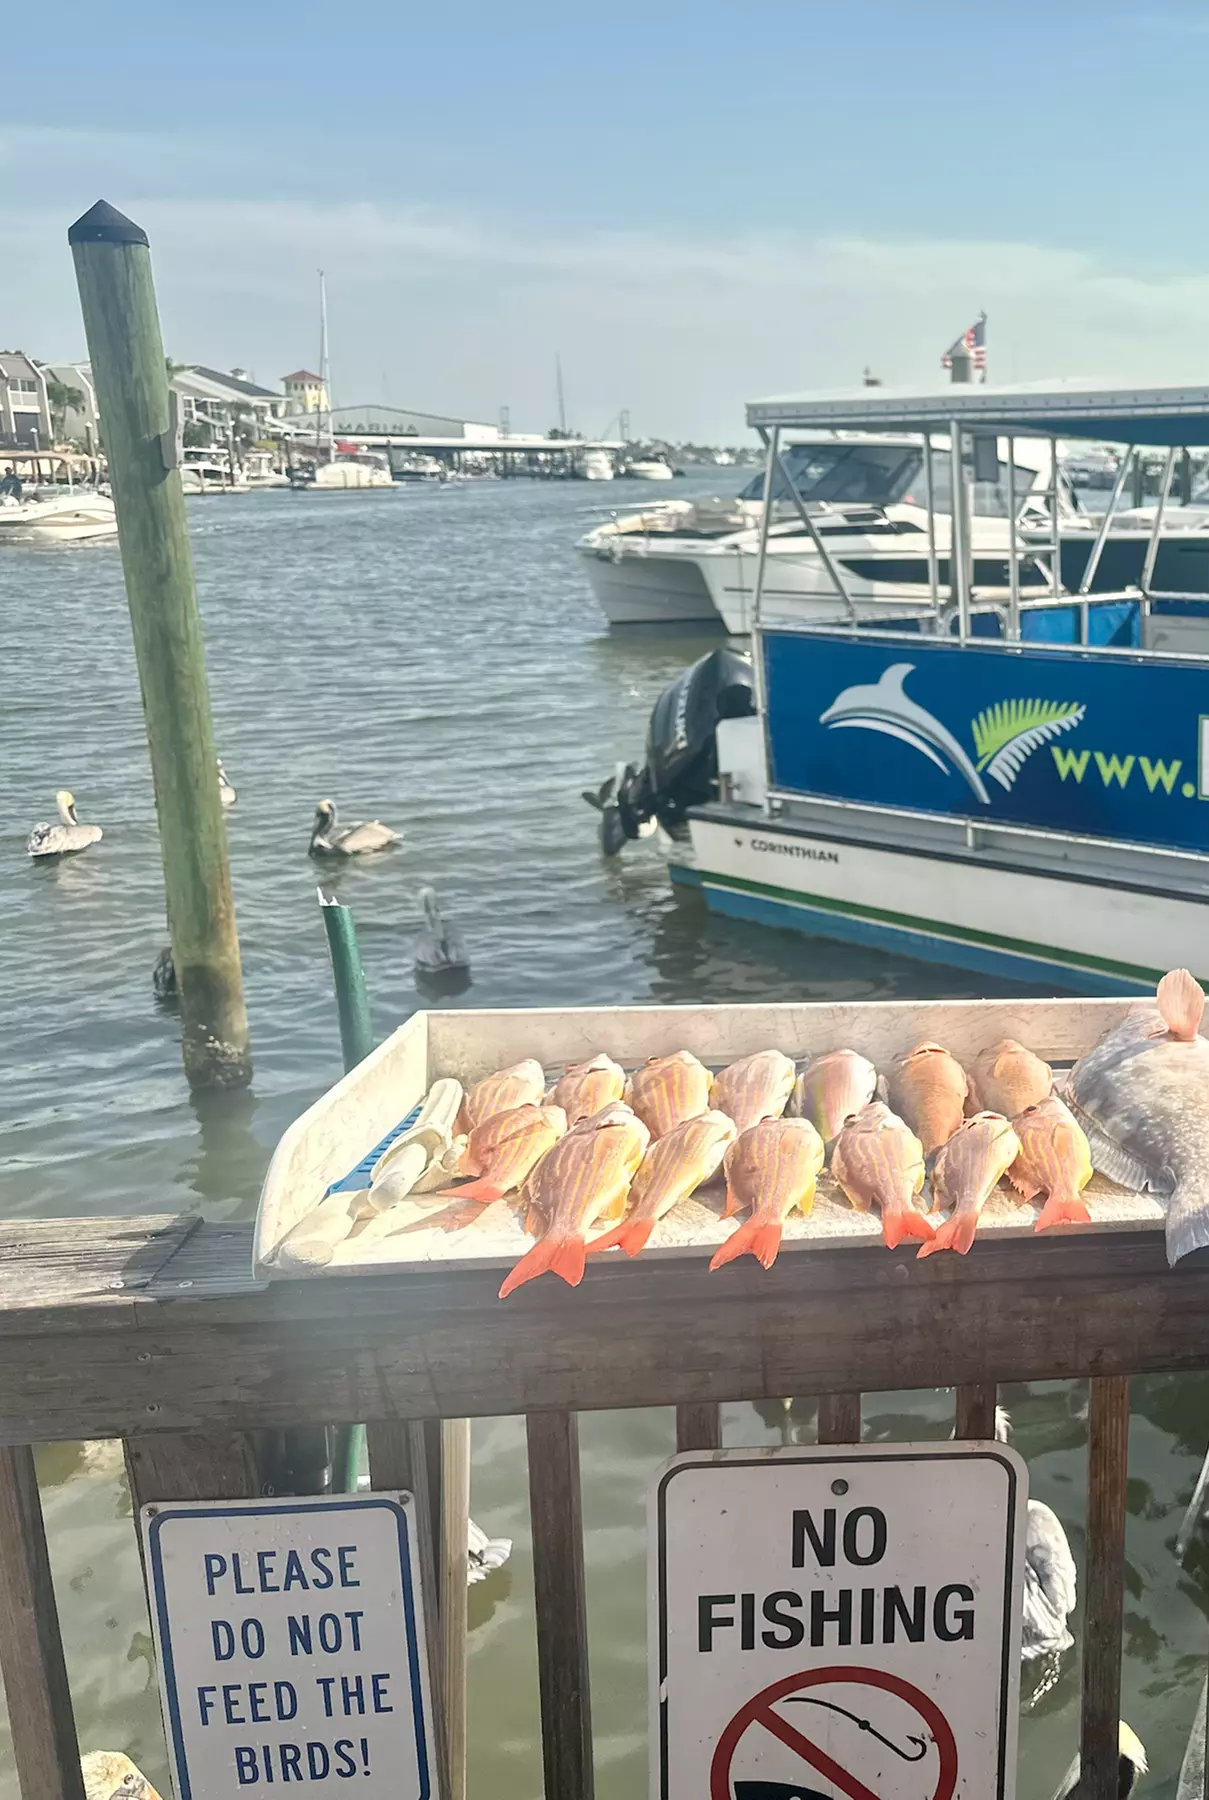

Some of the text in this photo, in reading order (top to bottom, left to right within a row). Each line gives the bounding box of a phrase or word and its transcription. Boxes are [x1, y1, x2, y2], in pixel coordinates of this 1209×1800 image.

[338, 423, 417, 433] MARINA
[751, 839, 838, 863] CORINTHIAN
[791, 1505, 888, 1569] NO
[203, 1545, 361, 1596] PLEASE
[211, 1611, 364, 1662] DO NOT
[698, 1583, 976, 1653] FISHING
[197, 1673, 394, 1727] FEED THE
[234, 1738, 371, 1786] BIRDS!
